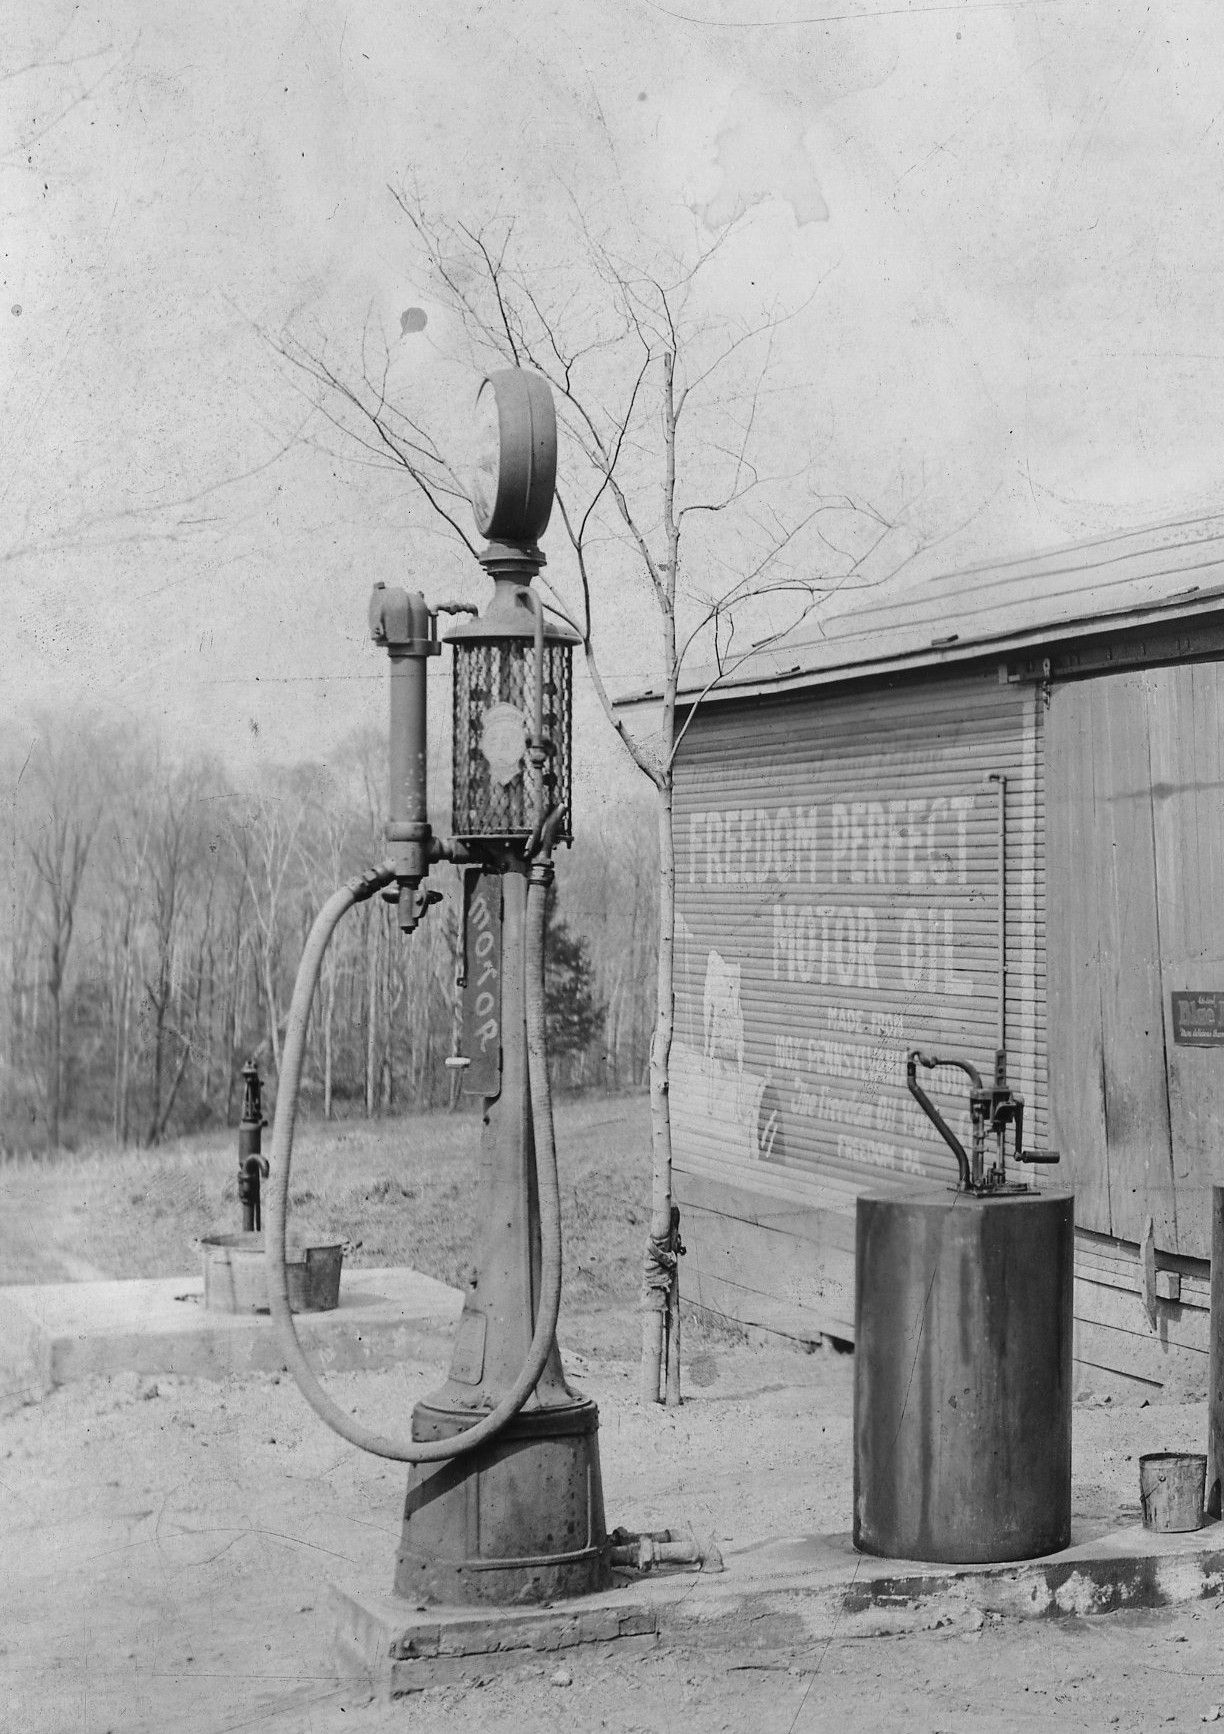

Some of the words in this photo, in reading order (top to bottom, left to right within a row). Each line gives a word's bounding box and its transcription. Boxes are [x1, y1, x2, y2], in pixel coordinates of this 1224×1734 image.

[688, 805, 817, 884] FREEDOM
[831, 796, 974, 885] PERFECT
[772, 903, 879, 989] MOTOR
[901, 907, 973, 997] OIL
